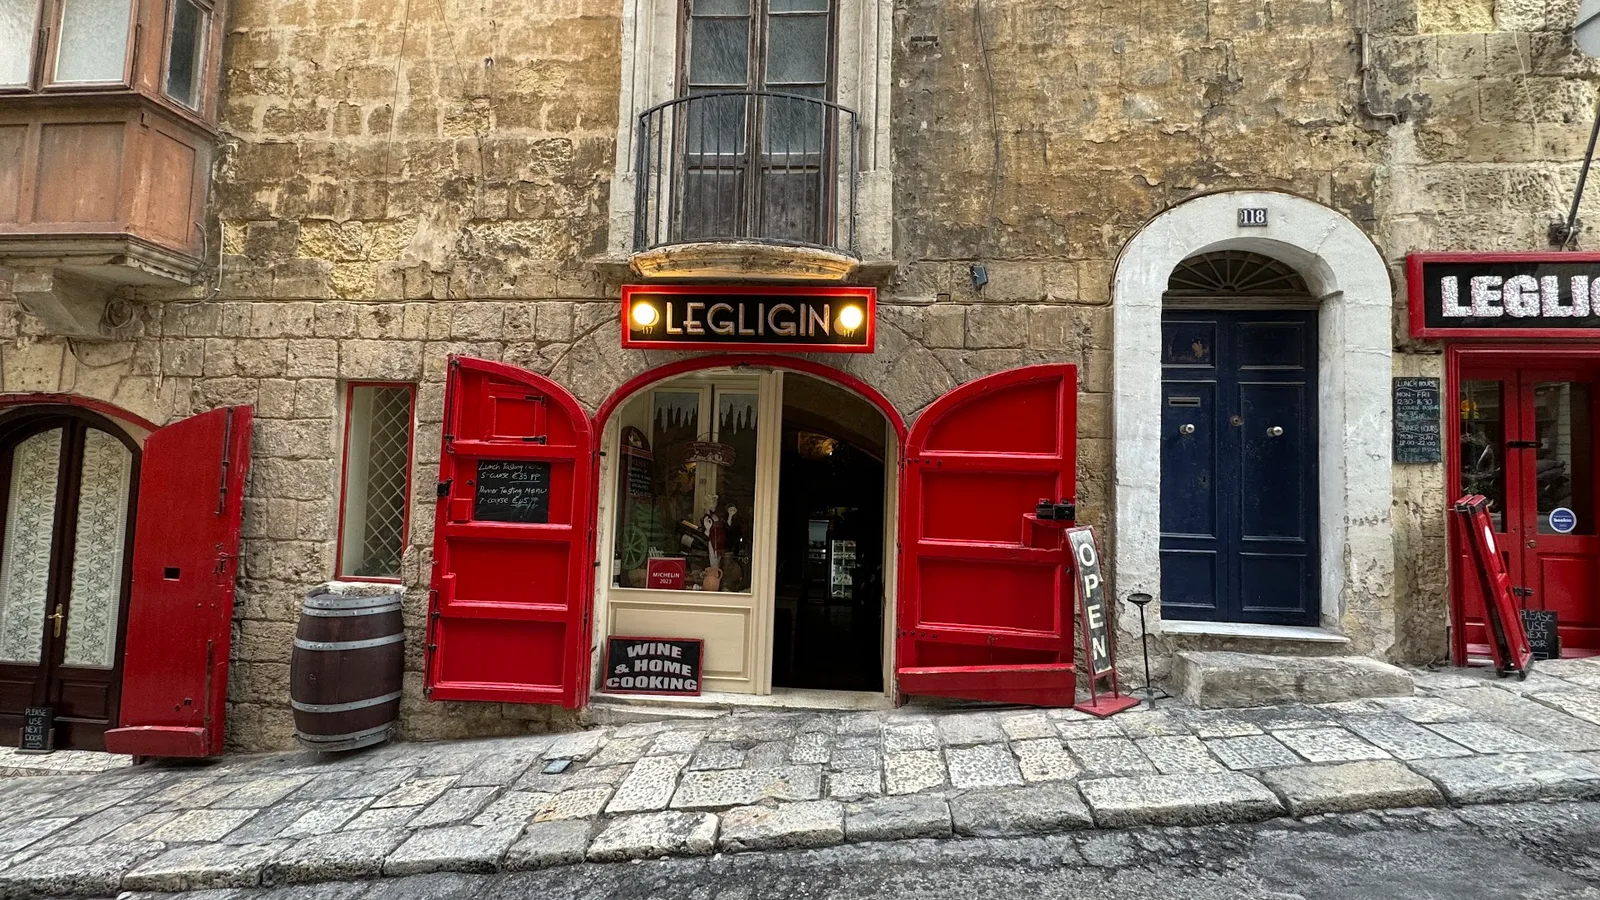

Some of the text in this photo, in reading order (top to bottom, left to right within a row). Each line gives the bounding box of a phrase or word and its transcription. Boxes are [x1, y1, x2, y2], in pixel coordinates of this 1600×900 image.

[1243, 209, 1265, 224] 118
[1441, 275, 1600, 318] LEGLI
[666, 301, 830, 336] LEGLIGIN
[642, 326, 653, 335] 117
[843, 330, 854, 338] 117
[1397, 380, 1418, 388] LUNCH
[479, 462, 500, 471] Lunch
[500, 486, 522, 497] Tasting
[1078, 542, 1107, 661] OPEN
[1520, 610, 1553, 622] PLEASE
[1527, 621, 1547, 631] USE
[1528, 640, 1546, 648] OOR
[626, 642, 683, 659] WINE
[614, 659, 692, 677] & HOME
[606, 676, 698, 690] COOKING
[25, 708, 47, 716] PLEASE
[28, 717, 43, 725] USE
[25, 726, 43, 734] NEXT
[25, 734, 42, 742] DOOR
